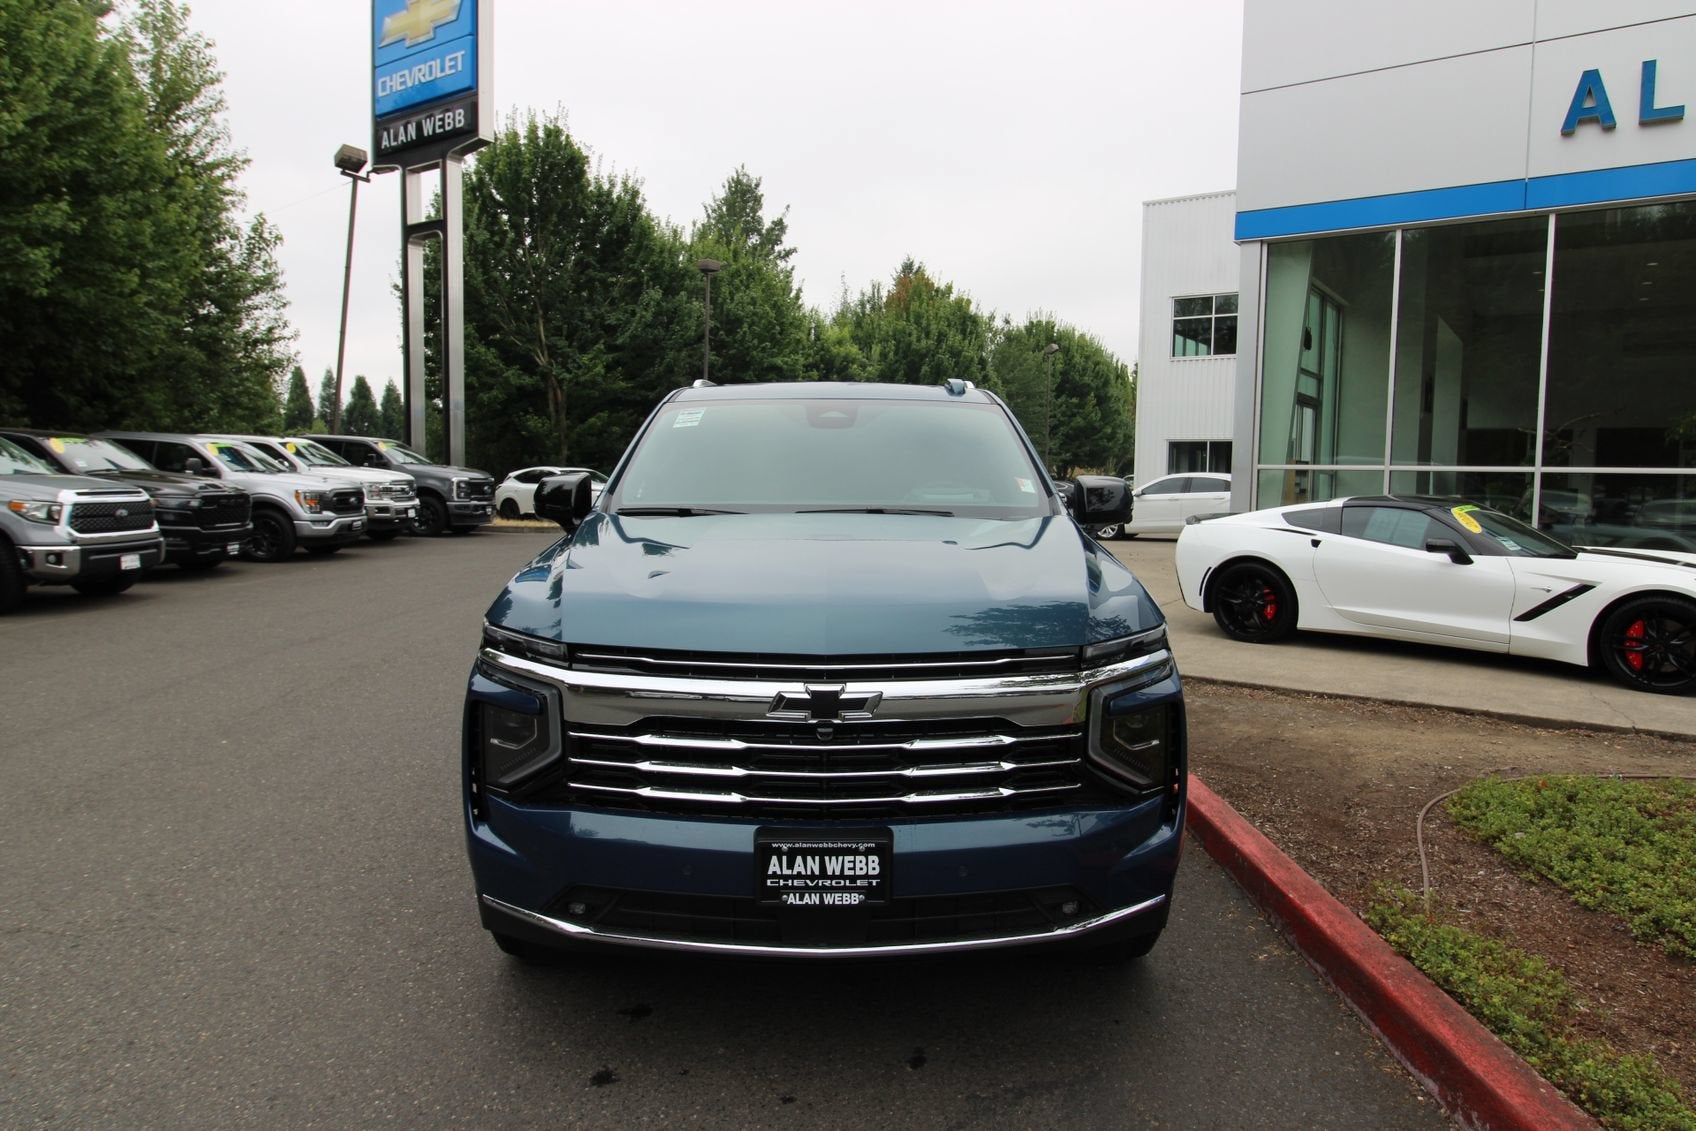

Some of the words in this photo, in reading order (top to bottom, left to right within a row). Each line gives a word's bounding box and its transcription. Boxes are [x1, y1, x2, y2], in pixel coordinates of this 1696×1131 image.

[377, 50, 465, 97] CHEVROLET
[1560, 58, 1686, 136] AL
[381, 121, 417, 149] ALAN
[421, 108, 465, 137] WEBB
[767, 855, 820, 875] ALAN
[824, 855, 880, 875] WEBB
[766, 879, 881, 887] CHEVROLET
[787, 893, 820, 905] ALAN
[822, 893, 859, 905] WEBB
